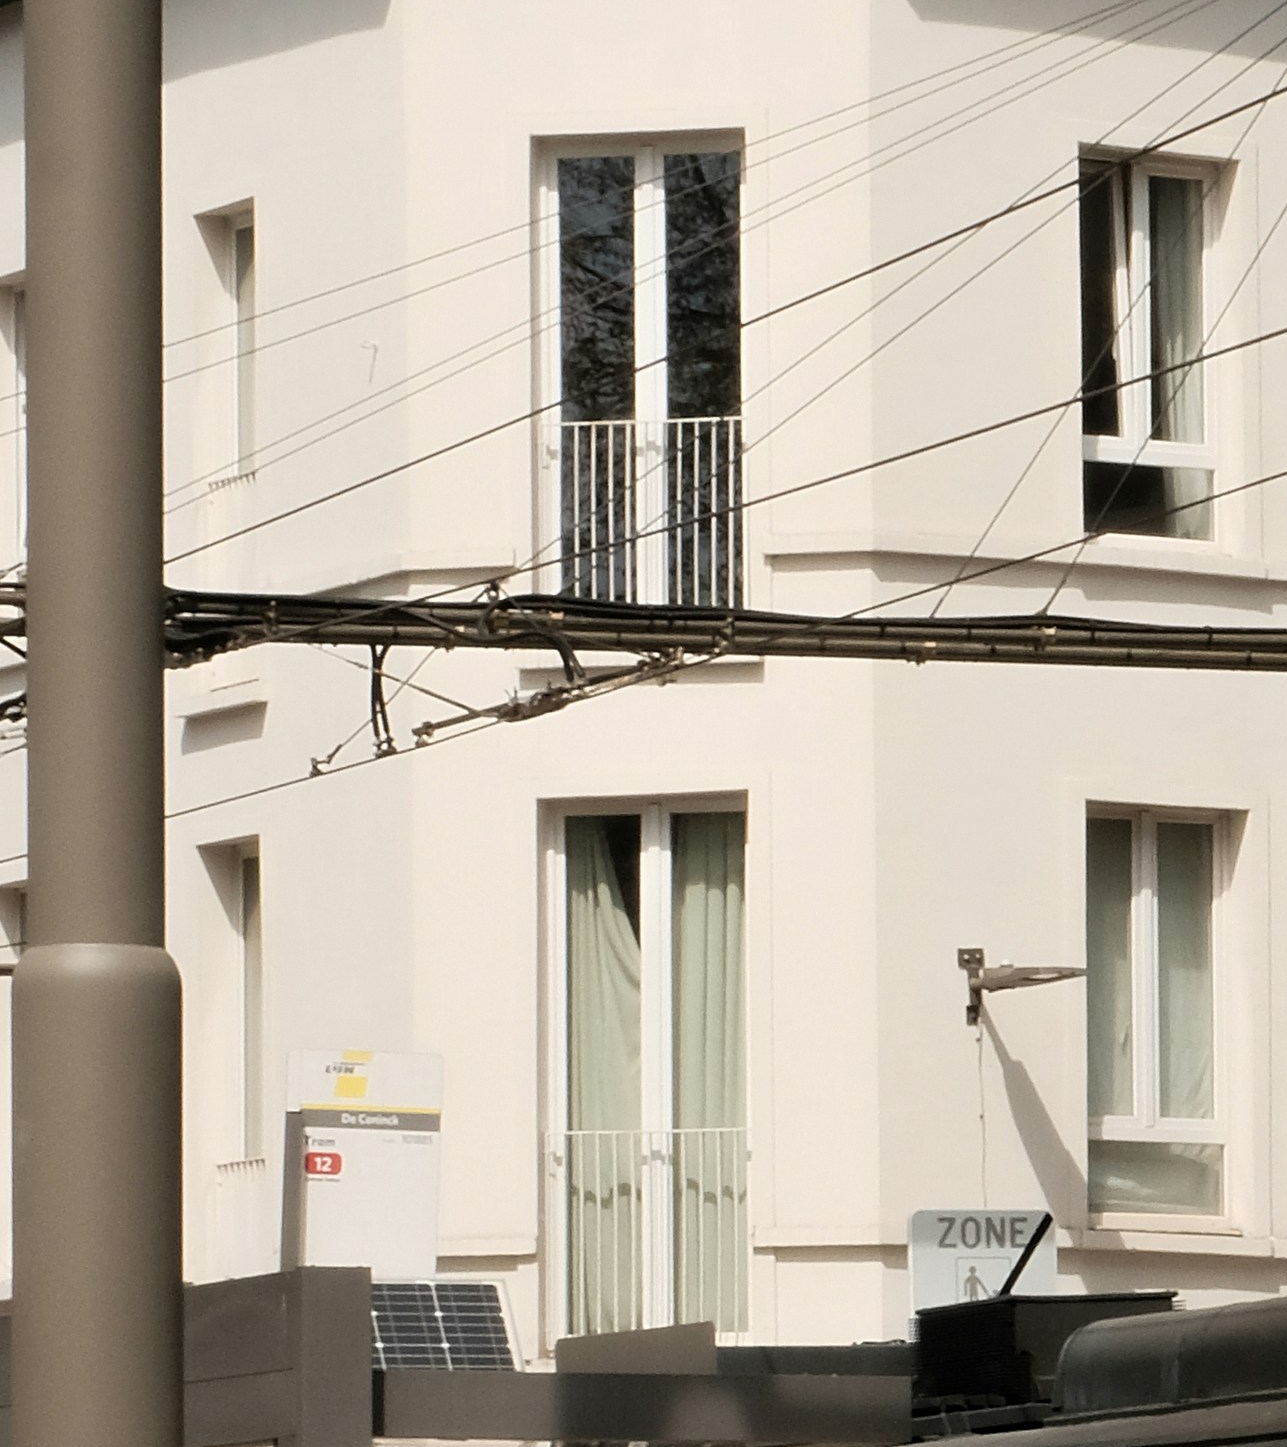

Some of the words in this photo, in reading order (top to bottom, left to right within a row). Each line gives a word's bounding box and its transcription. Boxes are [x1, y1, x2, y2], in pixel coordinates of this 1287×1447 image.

[341, 1112, 356, 1125] De
[314, 1156, 332, 1172] 12
[936, 1216, 1028, 1249] ZONE
